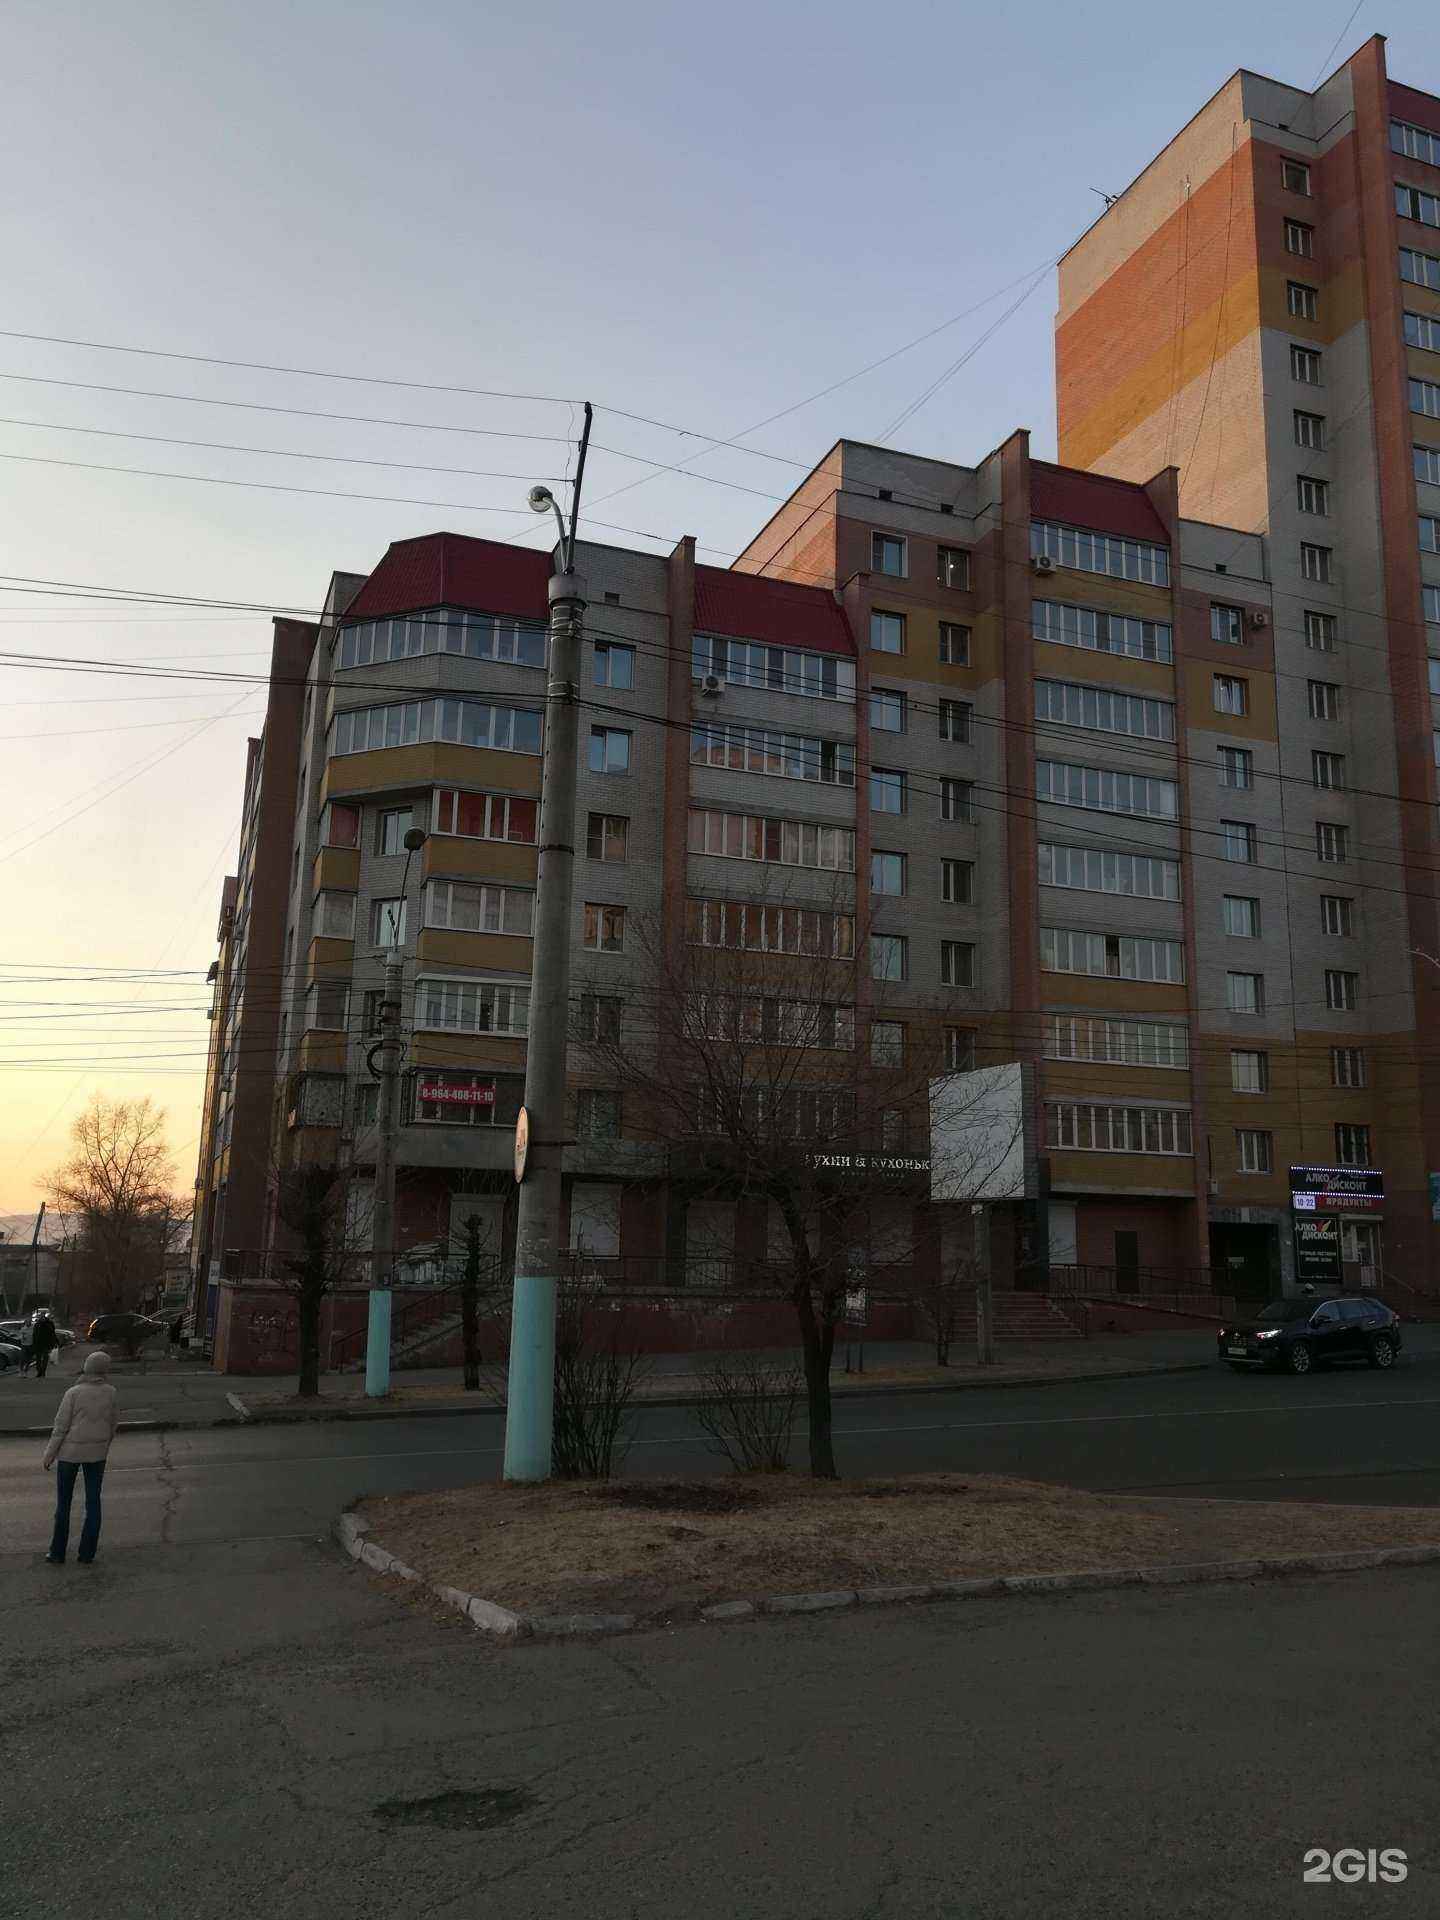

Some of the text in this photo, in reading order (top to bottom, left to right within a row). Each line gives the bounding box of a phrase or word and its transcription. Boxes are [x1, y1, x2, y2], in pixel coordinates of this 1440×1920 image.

[1305, 1172, 1330, 1184] АЛКО
[1327, 1180, 1367, 1192] ДИСКОНТ
[1295, 1222, 1318, 1232] АЛКО
[1302, 1231, 1338, 1241] ДИСКОНТ
